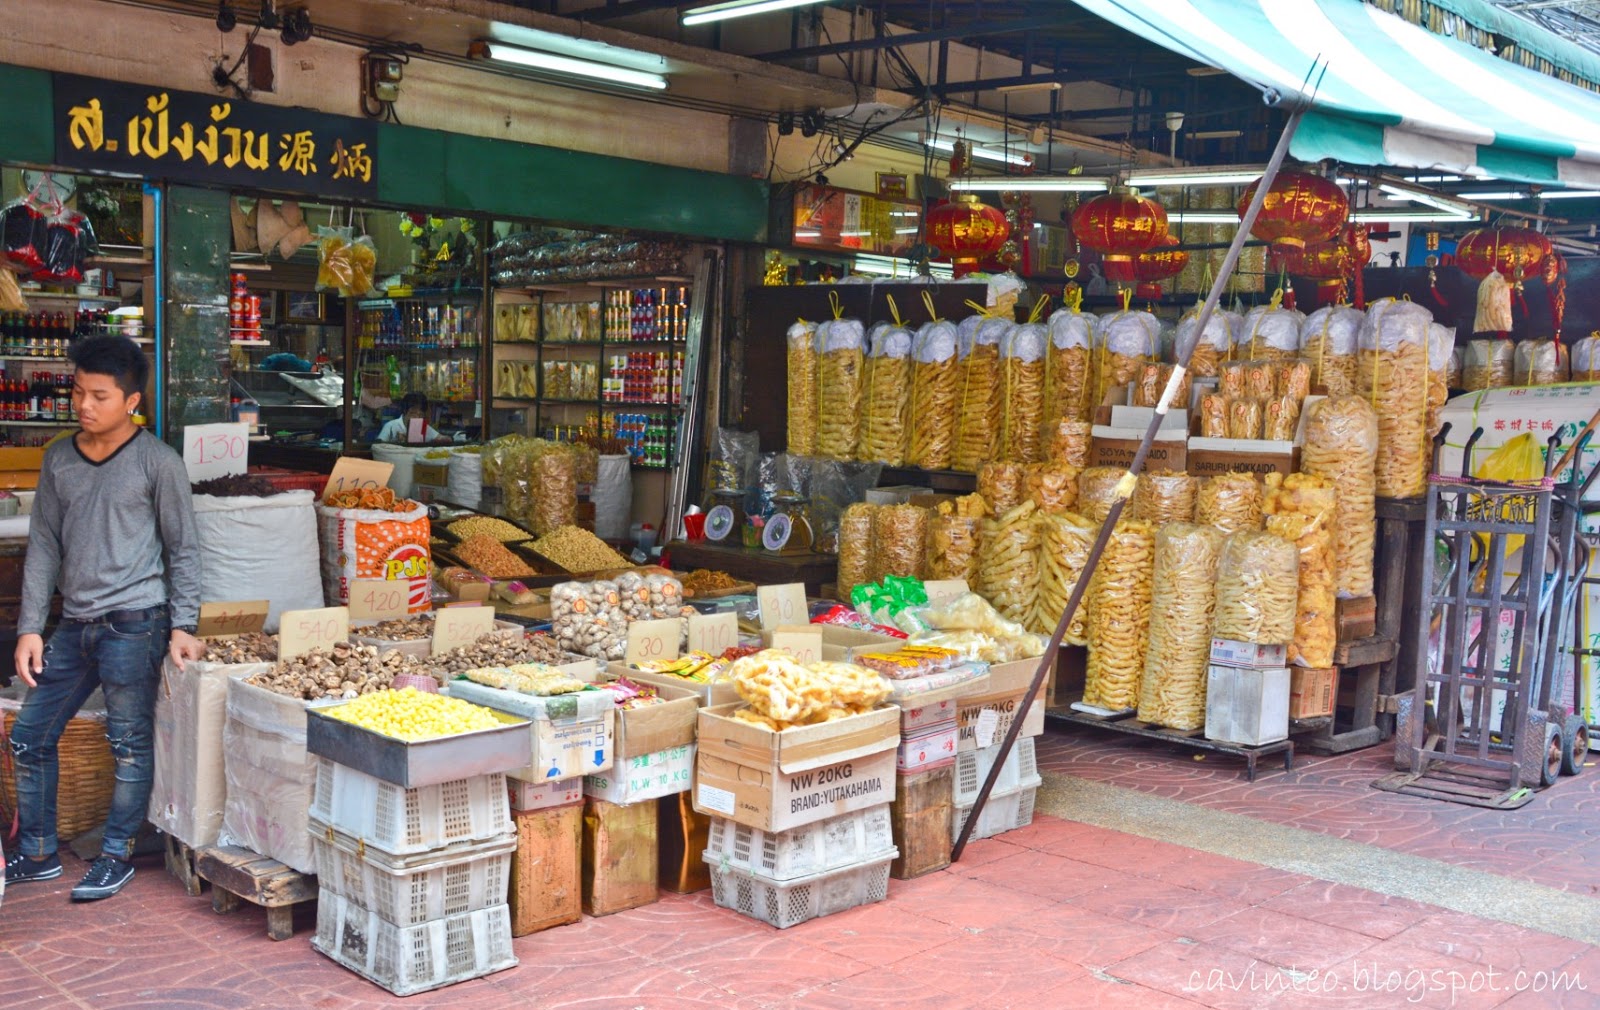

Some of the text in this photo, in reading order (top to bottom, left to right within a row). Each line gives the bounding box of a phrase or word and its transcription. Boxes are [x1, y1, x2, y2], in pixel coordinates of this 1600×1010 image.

[192, 433, 246, 466] 130
[384, 554, 428, 582] PJS
[362, 590, 401, 613] 420
[771, 598, 794, 621] 90
[299, 618, 340, 641] 540
[698, 623, 731, 652] 110
[638, 637, 663, 657] 30
[790, 763, 853, 793] NW 20KG
